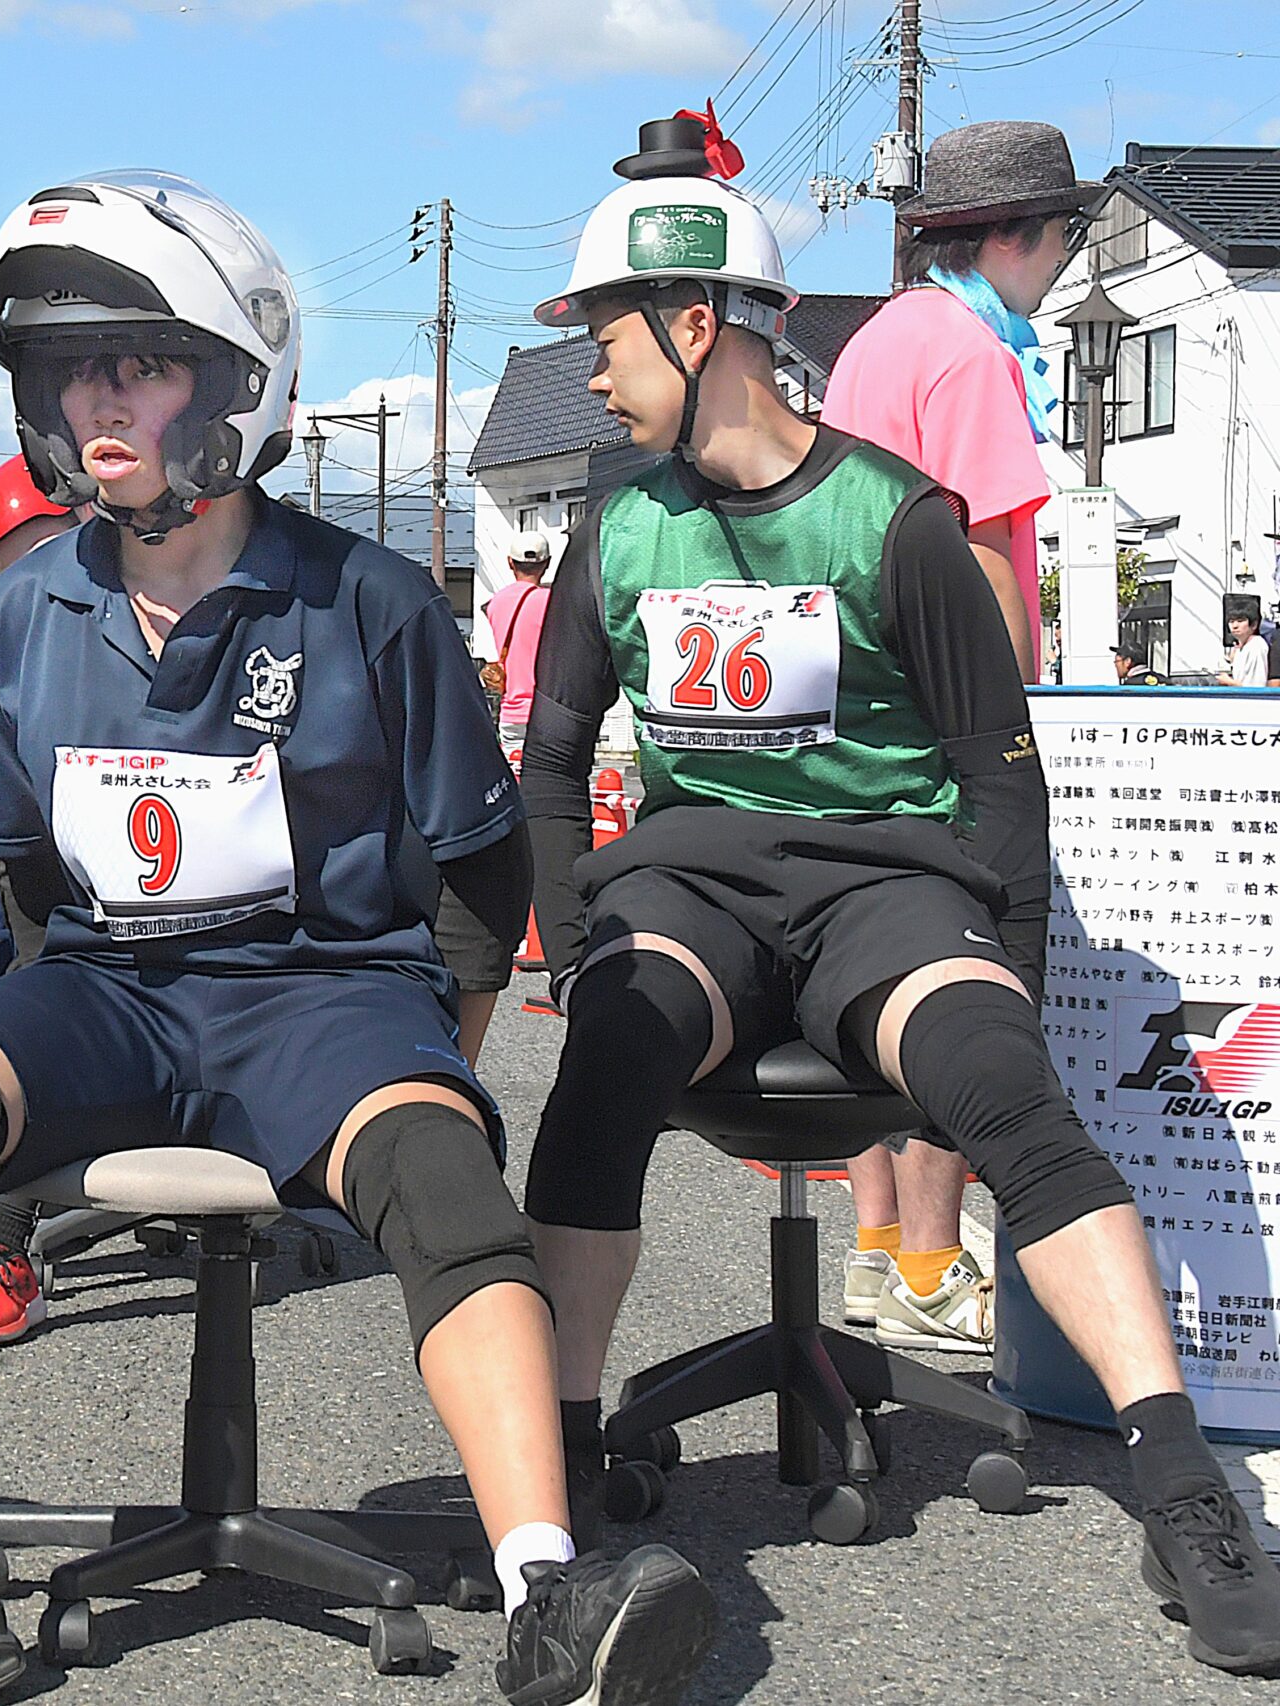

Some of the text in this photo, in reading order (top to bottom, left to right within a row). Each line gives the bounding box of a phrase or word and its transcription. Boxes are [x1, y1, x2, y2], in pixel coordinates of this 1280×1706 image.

[671, 623, 772, 712] 26
[101, 773, 211, 790] 奥州えさし大会
[127, 793, 182, 896] 9
[1045, 966, 1126, 982] こやさんやなぎ
[1161, 1095, 1272, 1120] ISU-1GP
[1173, 1307, 1267, 1327] 岩手日日新聞社
